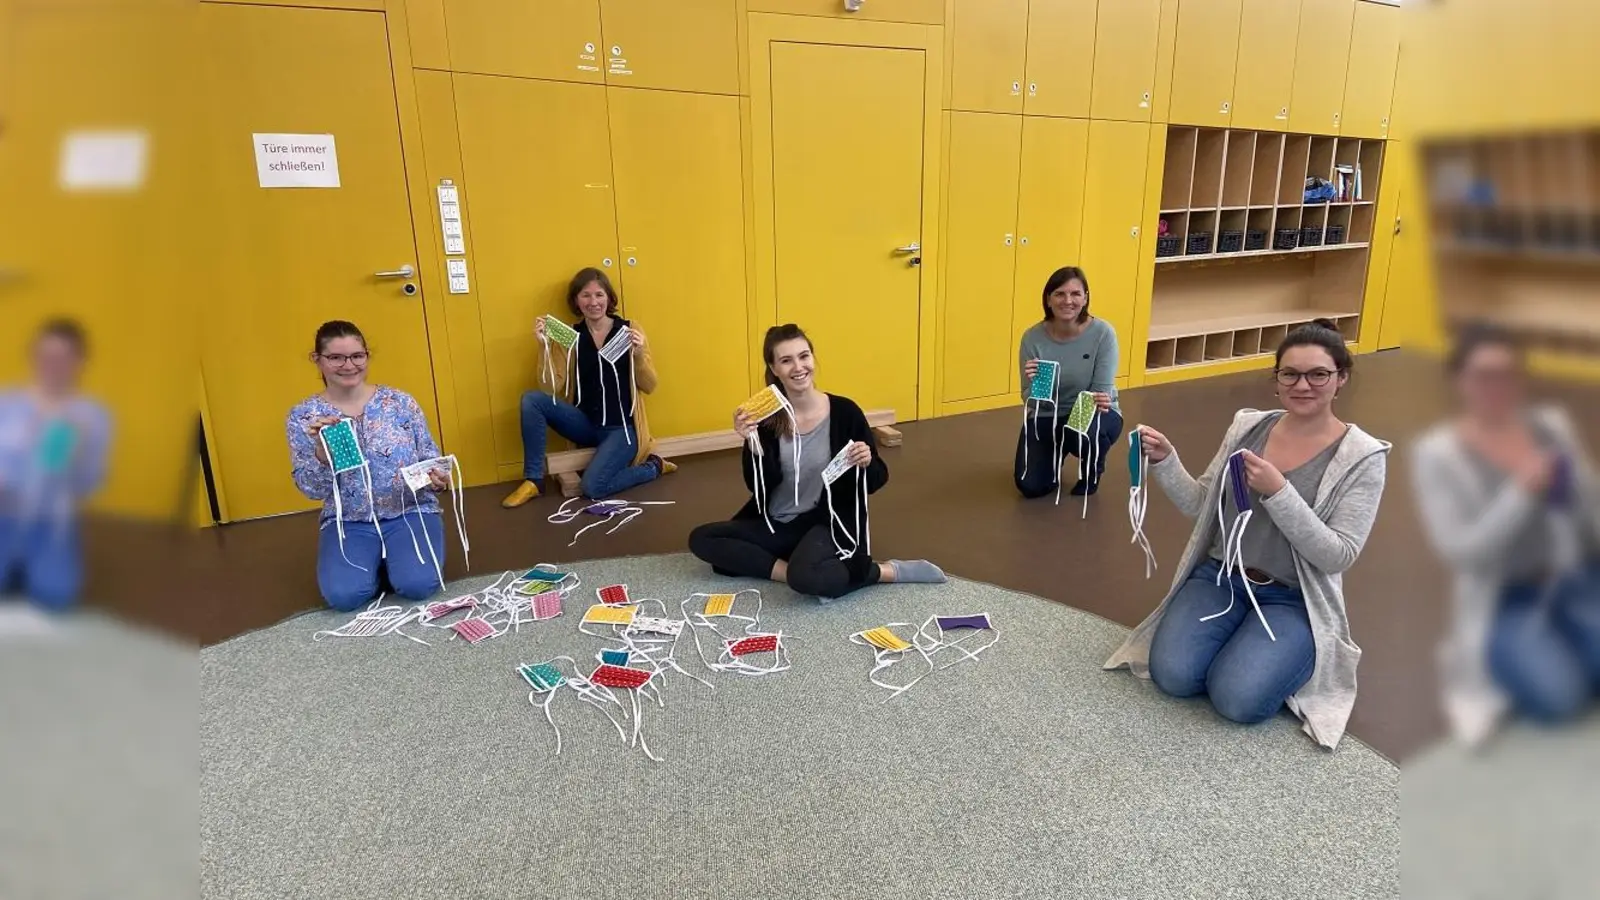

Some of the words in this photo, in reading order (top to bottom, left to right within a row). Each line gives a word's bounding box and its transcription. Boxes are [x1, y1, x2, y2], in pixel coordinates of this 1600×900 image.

[262, 144, 288, 153] Türe
[291, 144, 326, 154] immer
[269, 161, 325, 171] schließen!
